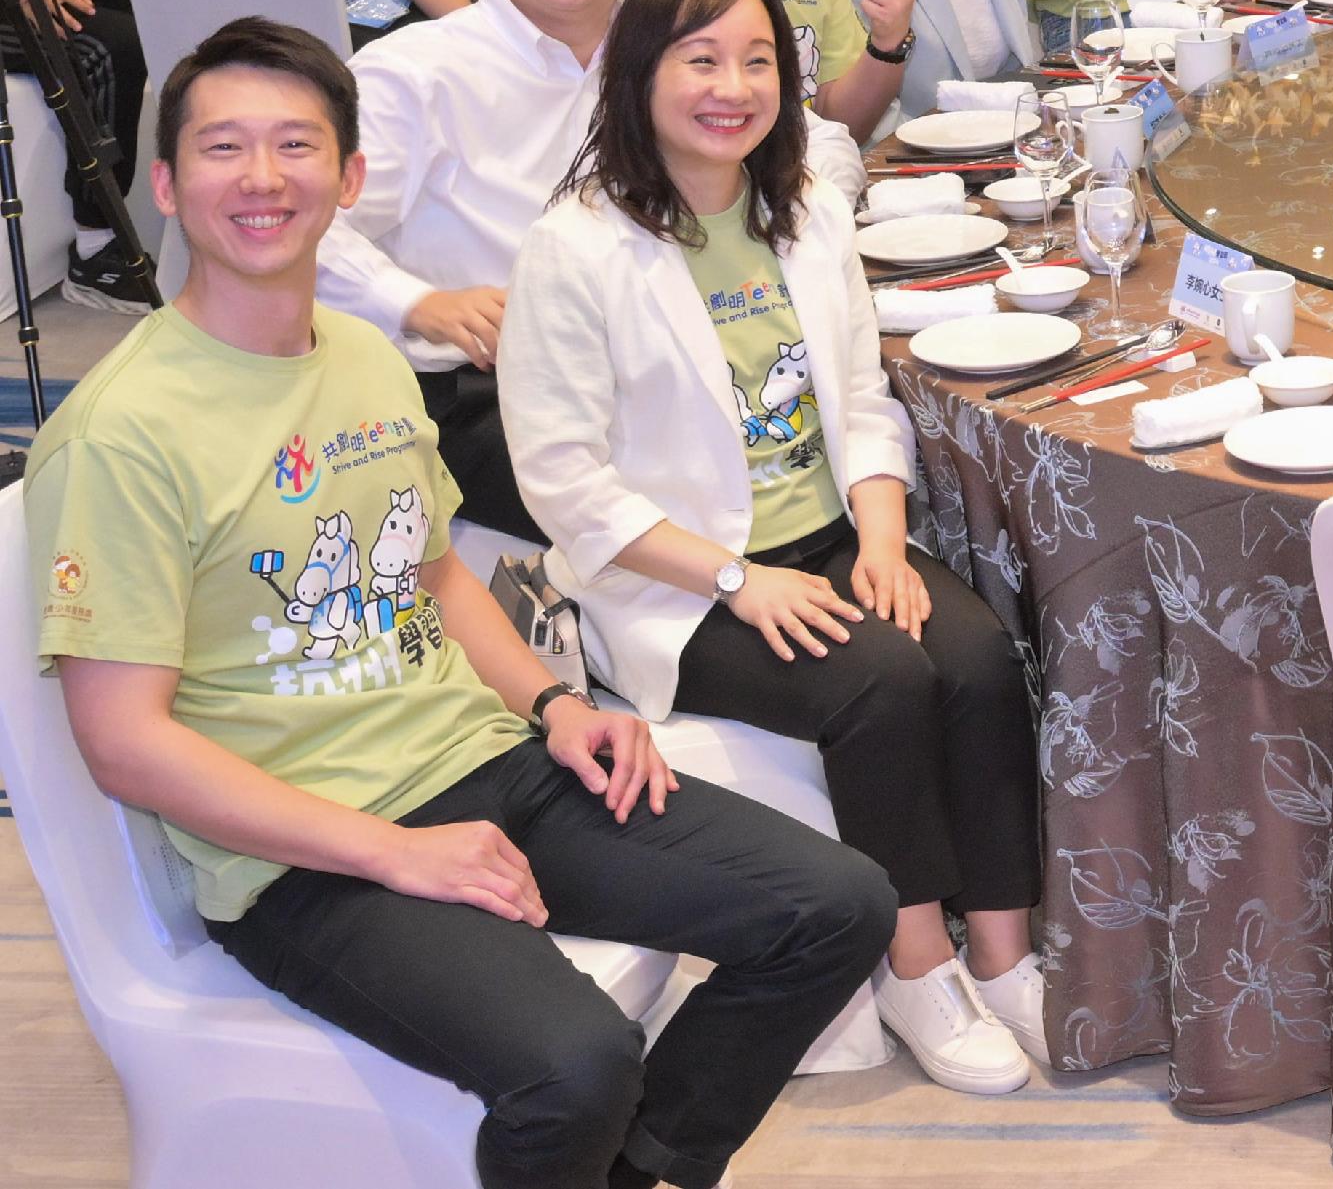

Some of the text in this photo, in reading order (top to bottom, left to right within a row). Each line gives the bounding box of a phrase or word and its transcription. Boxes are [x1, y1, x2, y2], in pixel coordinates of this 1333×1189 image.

[729, 310, 747, 323] and
[750, 305, 770, 316] Rise
[332, 462, 351, 474] Strive
[353, 455, 369, 467] and
[370, 450, 386, 461] Rise
